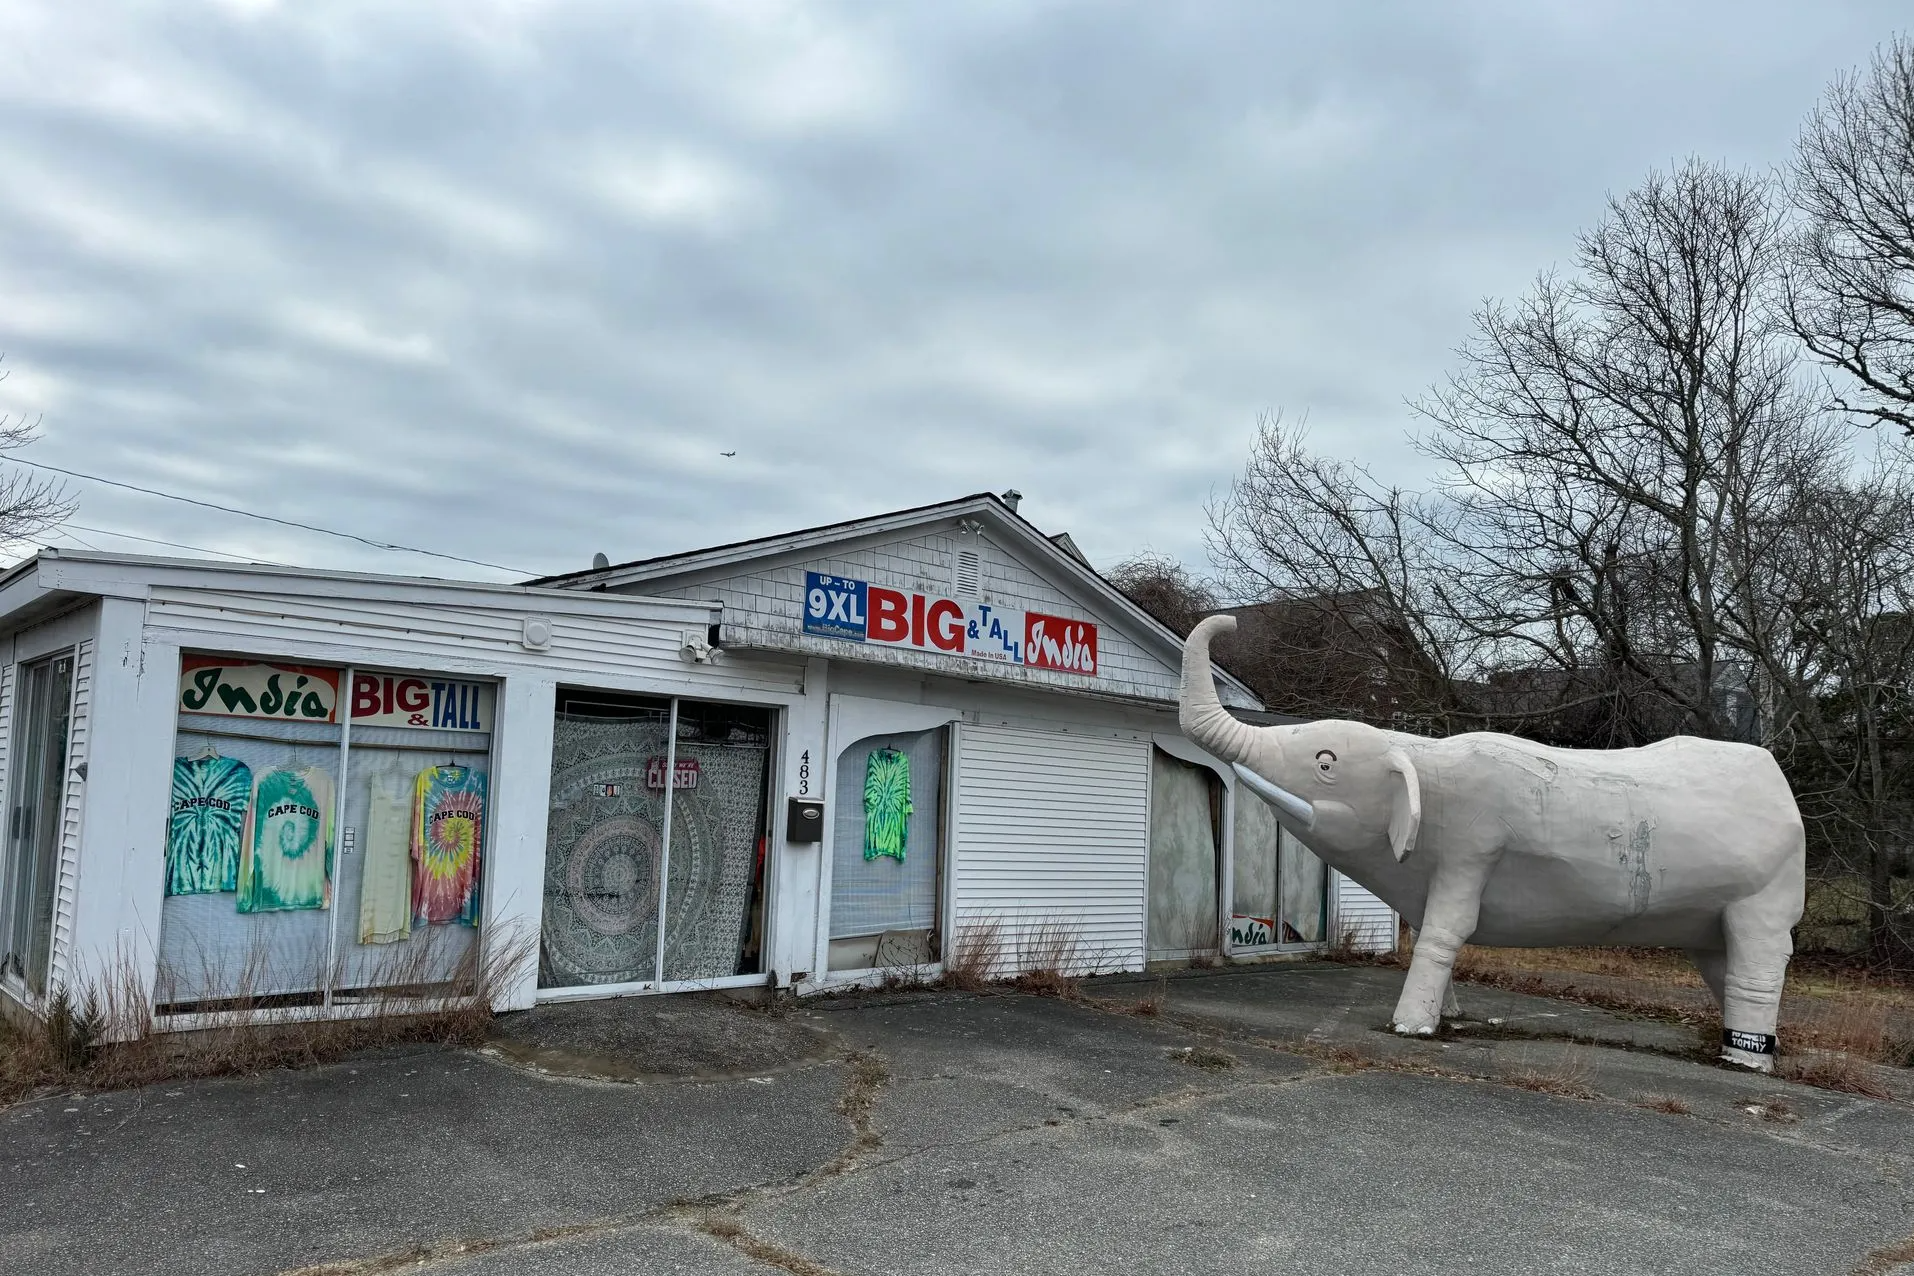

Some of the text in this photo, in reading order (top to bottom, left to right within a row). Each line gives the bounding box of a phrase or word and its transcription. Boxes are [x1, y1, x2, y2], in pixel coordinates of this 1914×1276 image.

[820, 576, 832, 586] UP
[842, 580, 855, 590] TO
[809, 588, 865, 625] 9XL
[867, 586, 1023, 663] BIG & TALL
[972, 649, 987, 658] Made
[994, 652, 1007, 660] USA
[1027, 620, 1094, 672] India
[183, 668, 329, 718] India
[351, 675, 480, 729] BIG & TALL
[648, 769, 697, 788] CLSED
[800, 749, 809, 794] 483
[174, 797, 230, 811] CAPE COD
[268, 805, 319, 819] CAPE COD
[457, 810, 474, 820] COD
[1232, 923, 1267, 945] ndia
[1732, 1037, 1766, 1052] TOMMY
